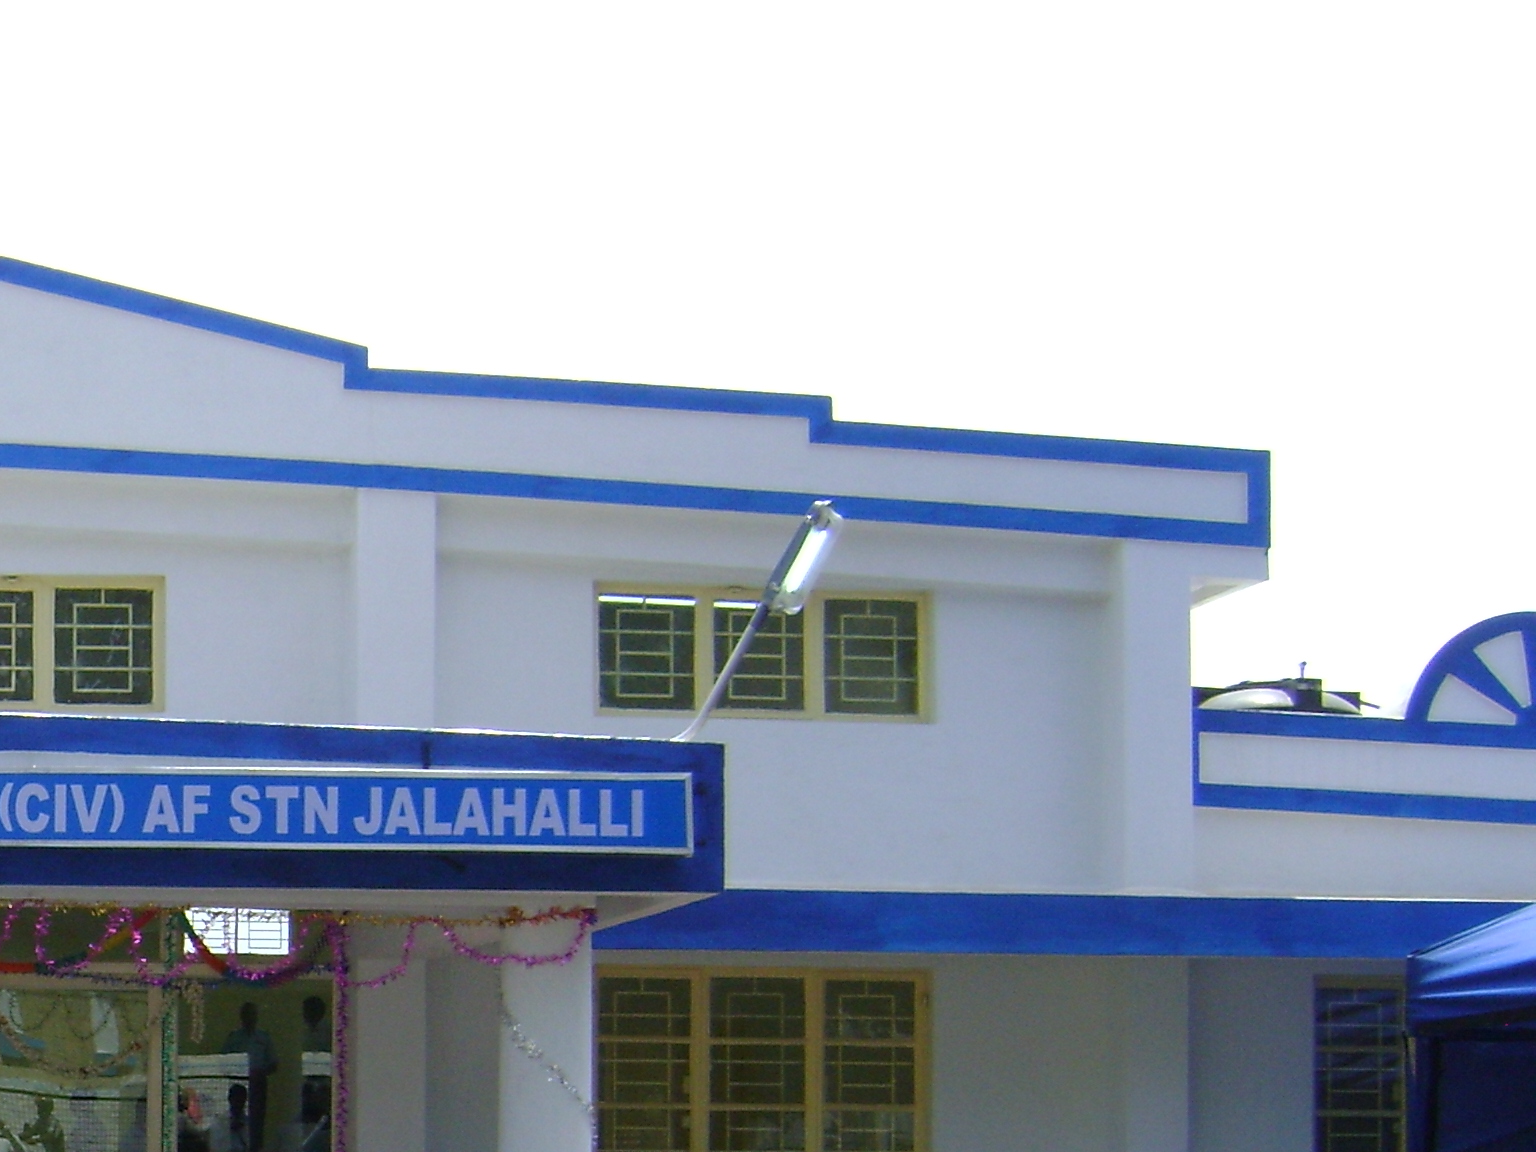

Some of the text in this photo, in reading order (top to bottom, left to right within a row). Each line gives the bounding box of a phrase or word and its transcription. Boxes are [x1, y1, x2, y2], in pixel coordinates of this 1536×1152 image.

[142, 785, 210, 833] AF
[229, 785, 338, 834] STN
[354, 787, 643, 836] JALAHALLI
